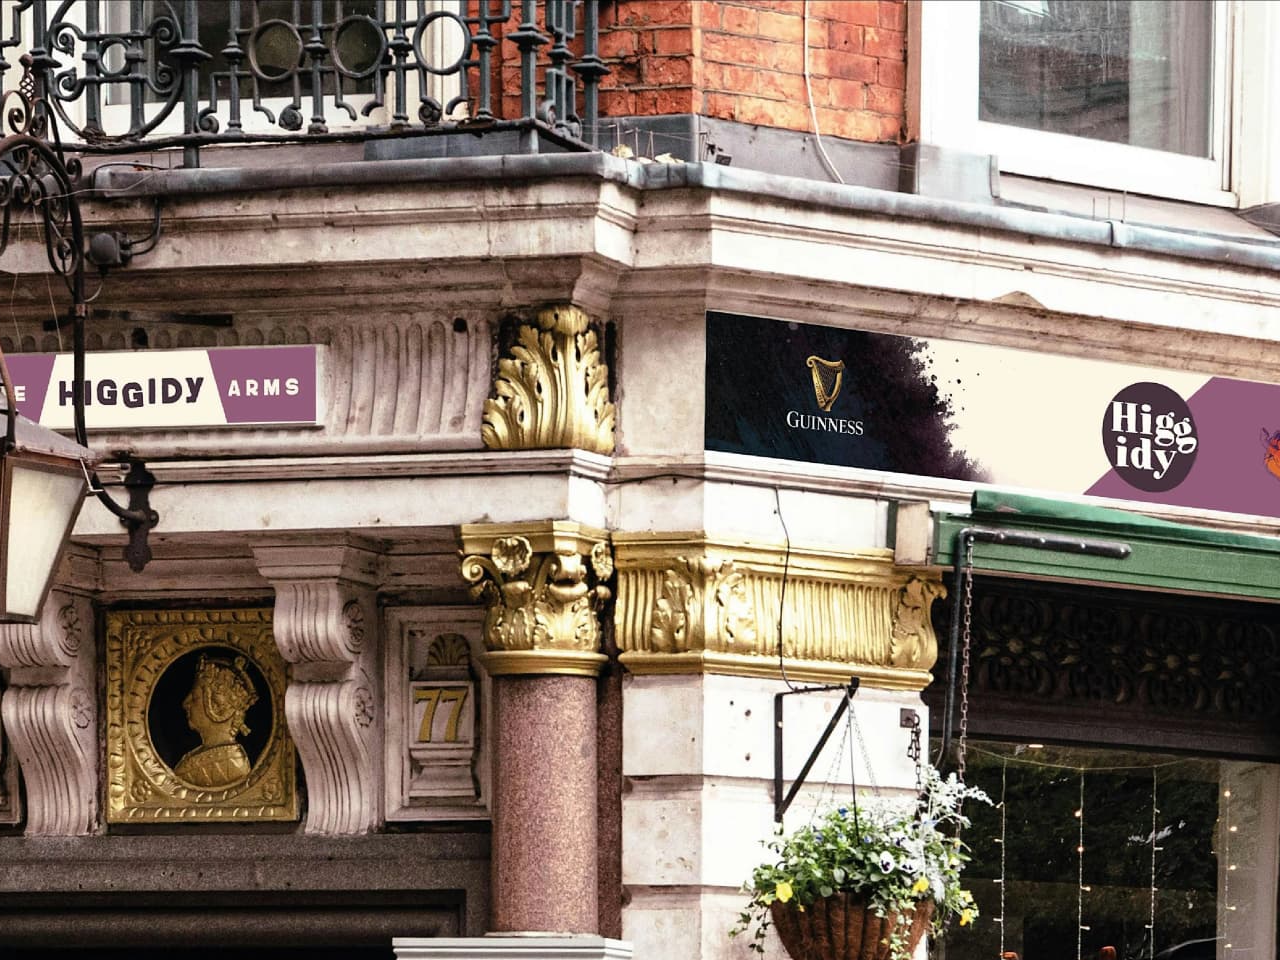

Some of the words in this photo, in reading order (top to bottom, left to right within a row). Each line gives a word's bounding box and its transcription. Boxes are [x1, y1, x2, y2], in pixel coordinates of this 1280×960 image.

[59, 376, 204, 408] HIGGIDY
[228, 377, 300, 397] ARMS
[786, 409, 864, 437] GUINNESS
[1111, 400, 1198, 455] Higg
[1115, 436, 1178, 479] idy
[414, 690, 468, 743] 77
